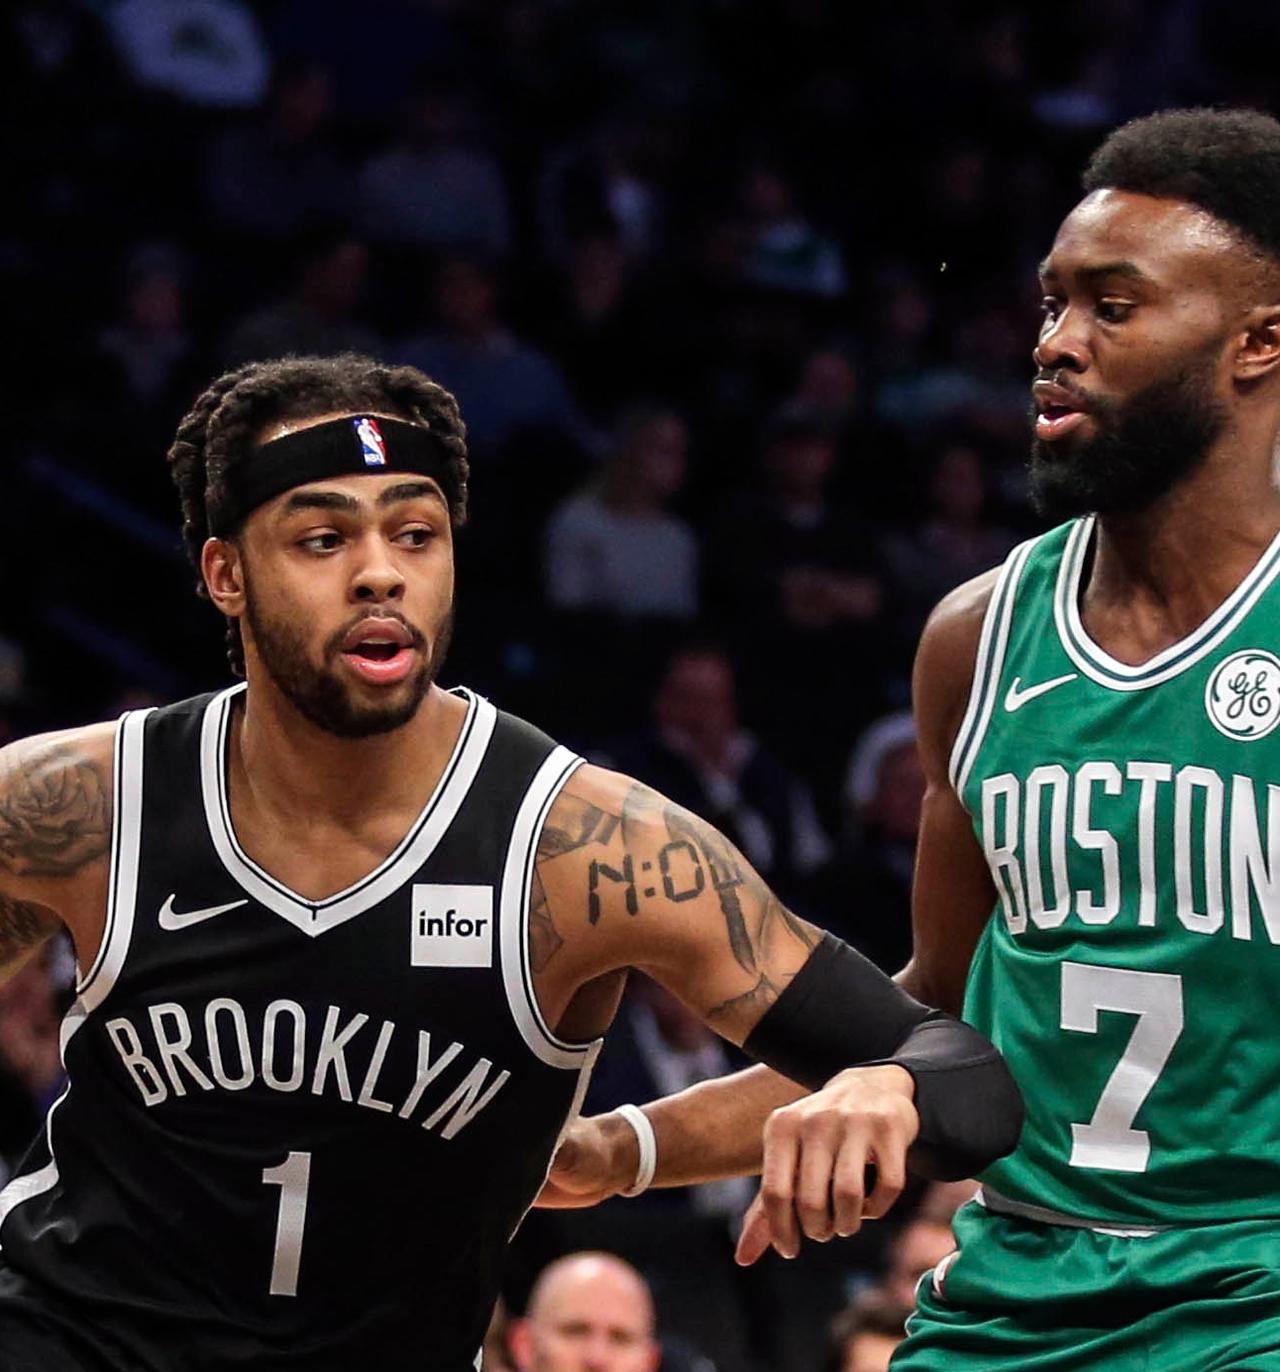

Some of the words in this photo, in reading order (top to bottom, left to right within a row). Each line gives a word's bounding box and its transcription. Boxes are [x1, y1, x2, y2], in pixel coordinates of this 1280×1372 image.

[418, 909, 488, 937] infor
[104, 996, 512, 1141] BROOKLYN
[1059, 960, 1185, 1173] 7
[261, 1150, 313, 1297] 1
